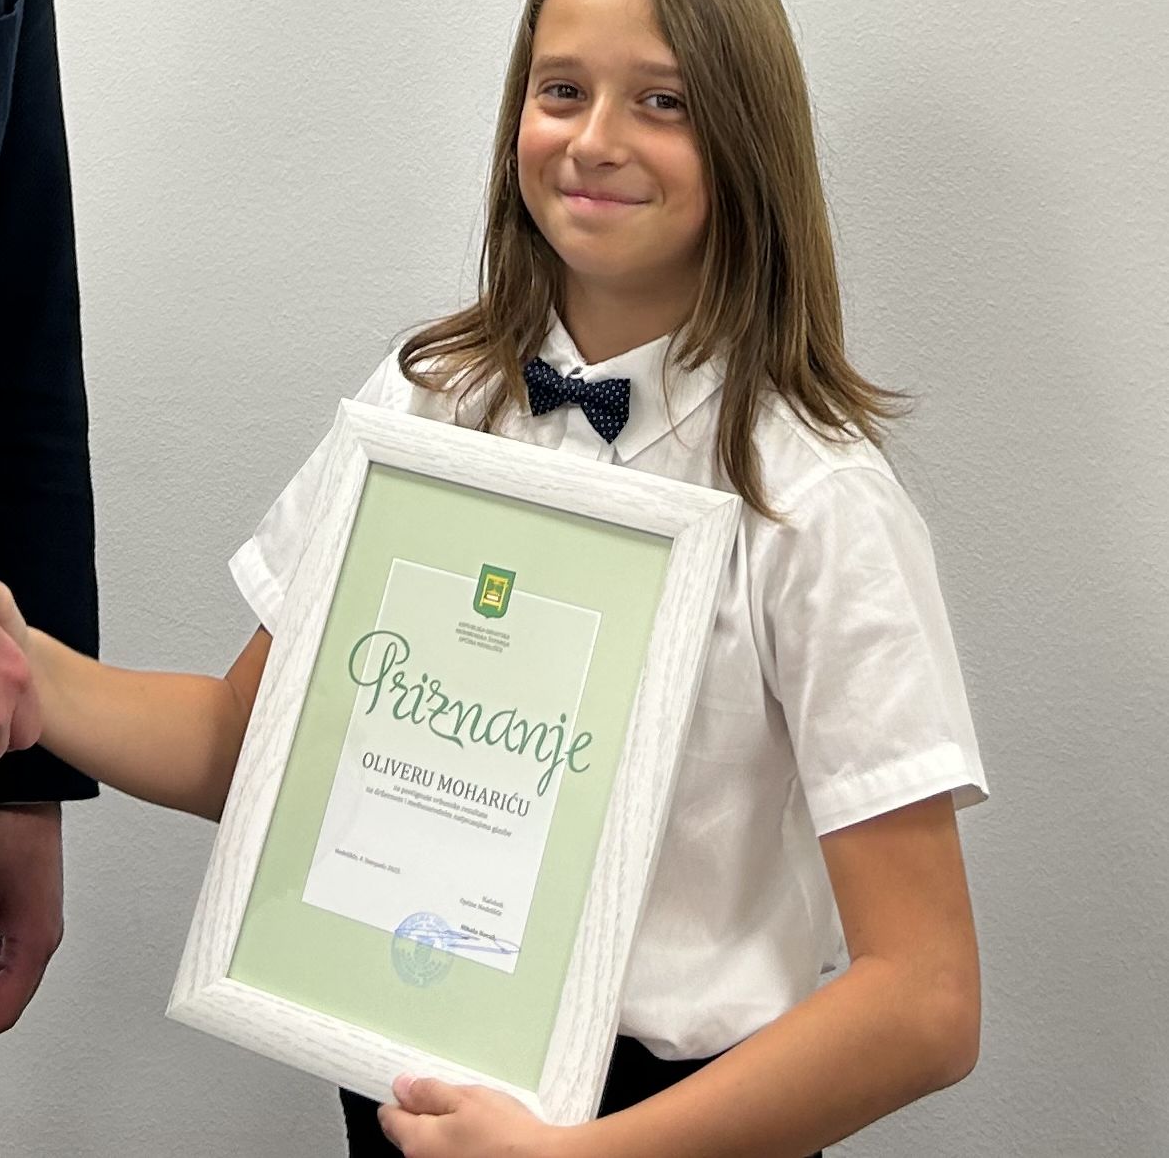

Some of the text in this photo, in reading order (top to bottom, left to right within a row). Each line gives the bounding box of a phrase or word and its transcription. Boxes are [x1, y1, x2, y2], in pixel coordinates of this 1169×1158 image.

[348, 630, 593, 797] Priznanje
[362, 751, 435, 788] OLIVERU
[436, 773, 531, 818] MOHARIĆU
